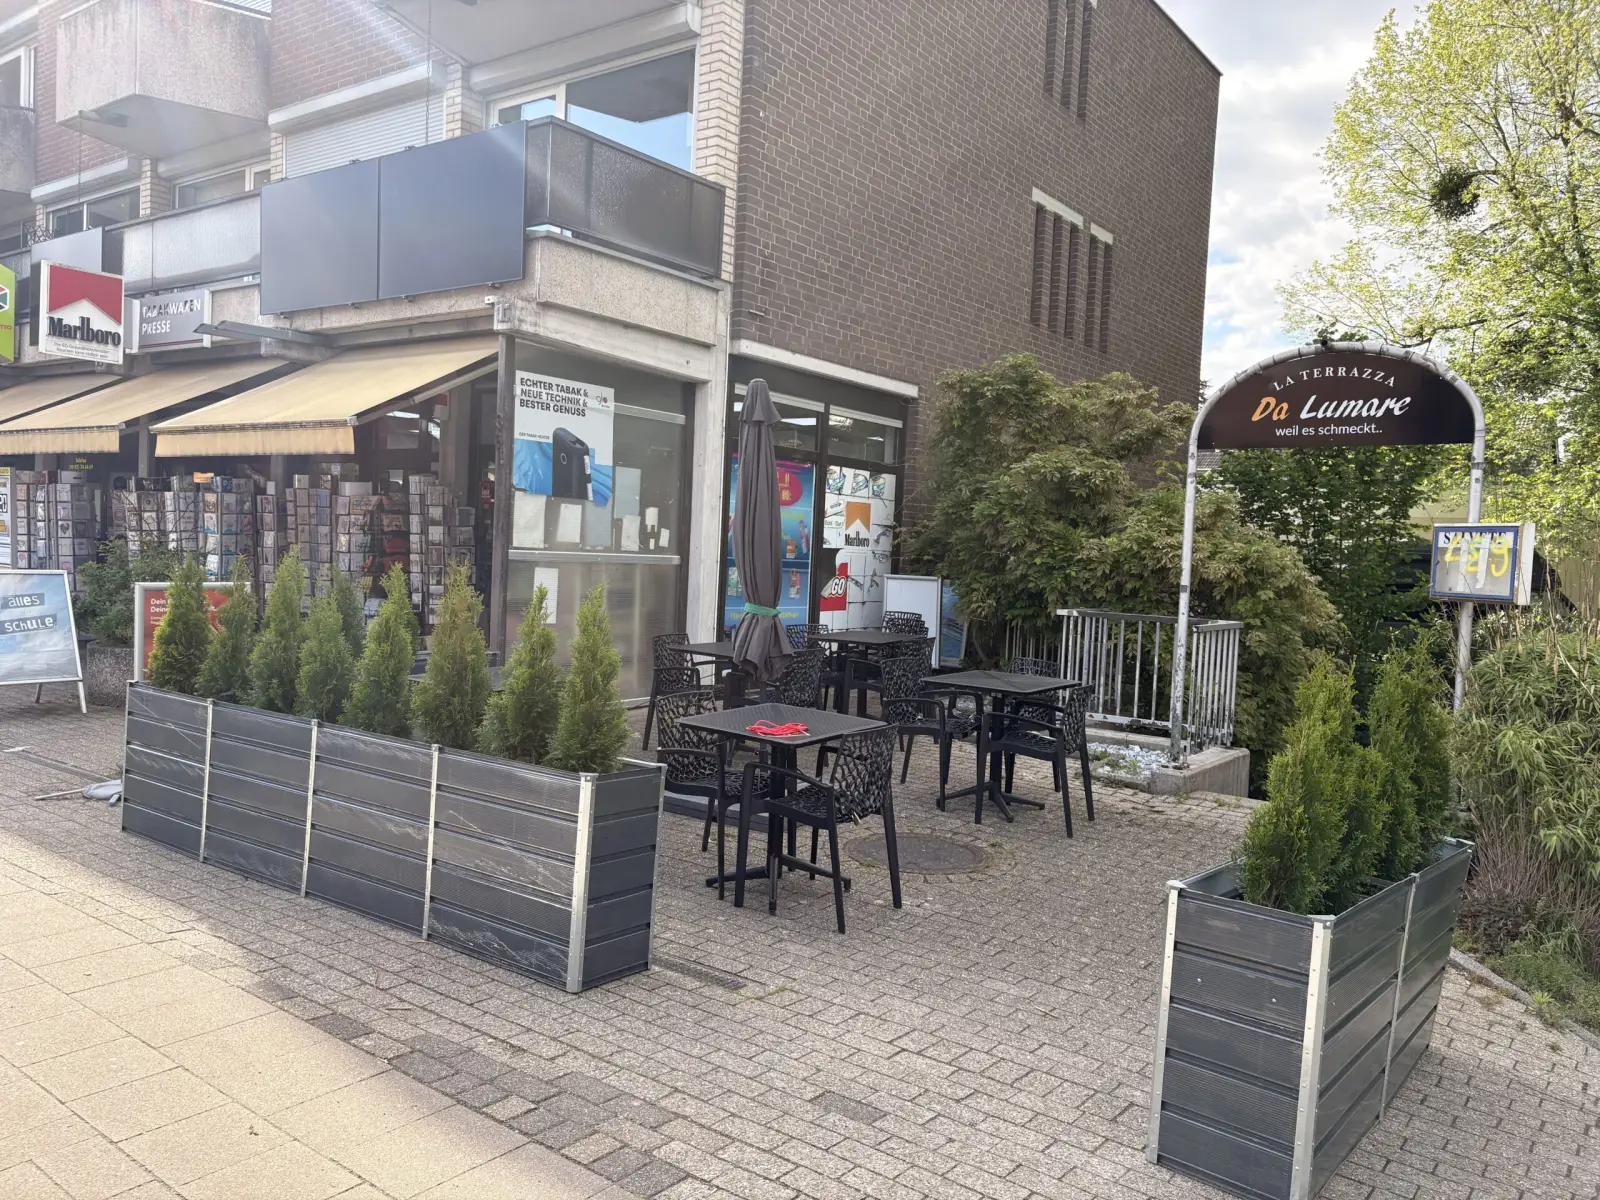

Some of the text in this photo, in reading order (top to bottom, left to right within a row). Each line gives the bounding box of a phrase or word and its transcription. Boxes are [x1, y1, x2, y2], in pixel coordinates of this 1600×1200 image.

[142, 299, 201, 318] TABAKWAREN
[46, 316, 121, 346] Marlboro
[142, 320, 171, 335] PRESSE
[520, 377, 589, 397] ECHTER TABAK &
[1273, 366, 1395, 391] LA TERRAZZA
[520, 388, 543, 400] NEUE
[545, 391, 581, 406] TECHNIK
[582, 398, 588, 408] &
[520, 398, 586, 417] BESTER GENUSS
[1251, 394, 1411, 421] Da Lumare
[1275, 422, 1383, 436] weil es schmeckt..
[844, 531, 870, 548] Marlboro
[831, 577, 845, 595] GO
[8, 595, 40, 607] alles
